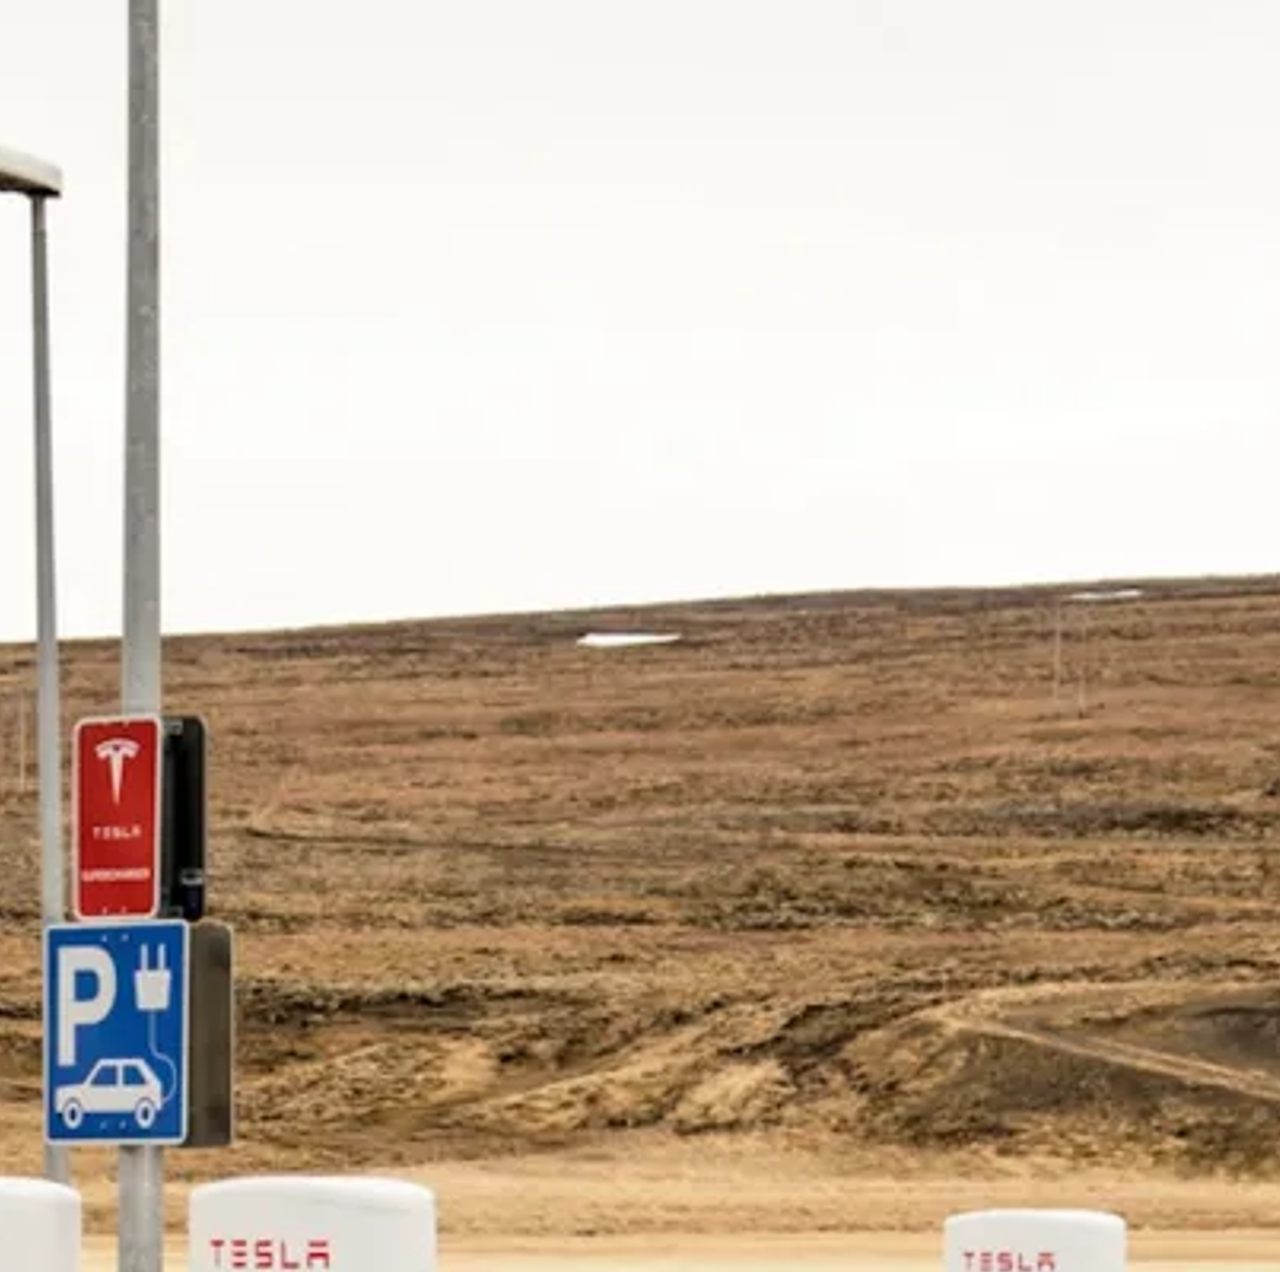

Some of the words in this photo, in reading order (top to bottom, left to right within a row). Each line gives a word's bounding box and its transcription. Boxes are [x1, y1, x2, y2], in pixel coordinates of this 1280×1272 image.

[57, 945, 118, 1066] P
[210, 1238, 331, 1270] TESLA
[963, 1251, 1056, 1272] TESLA
